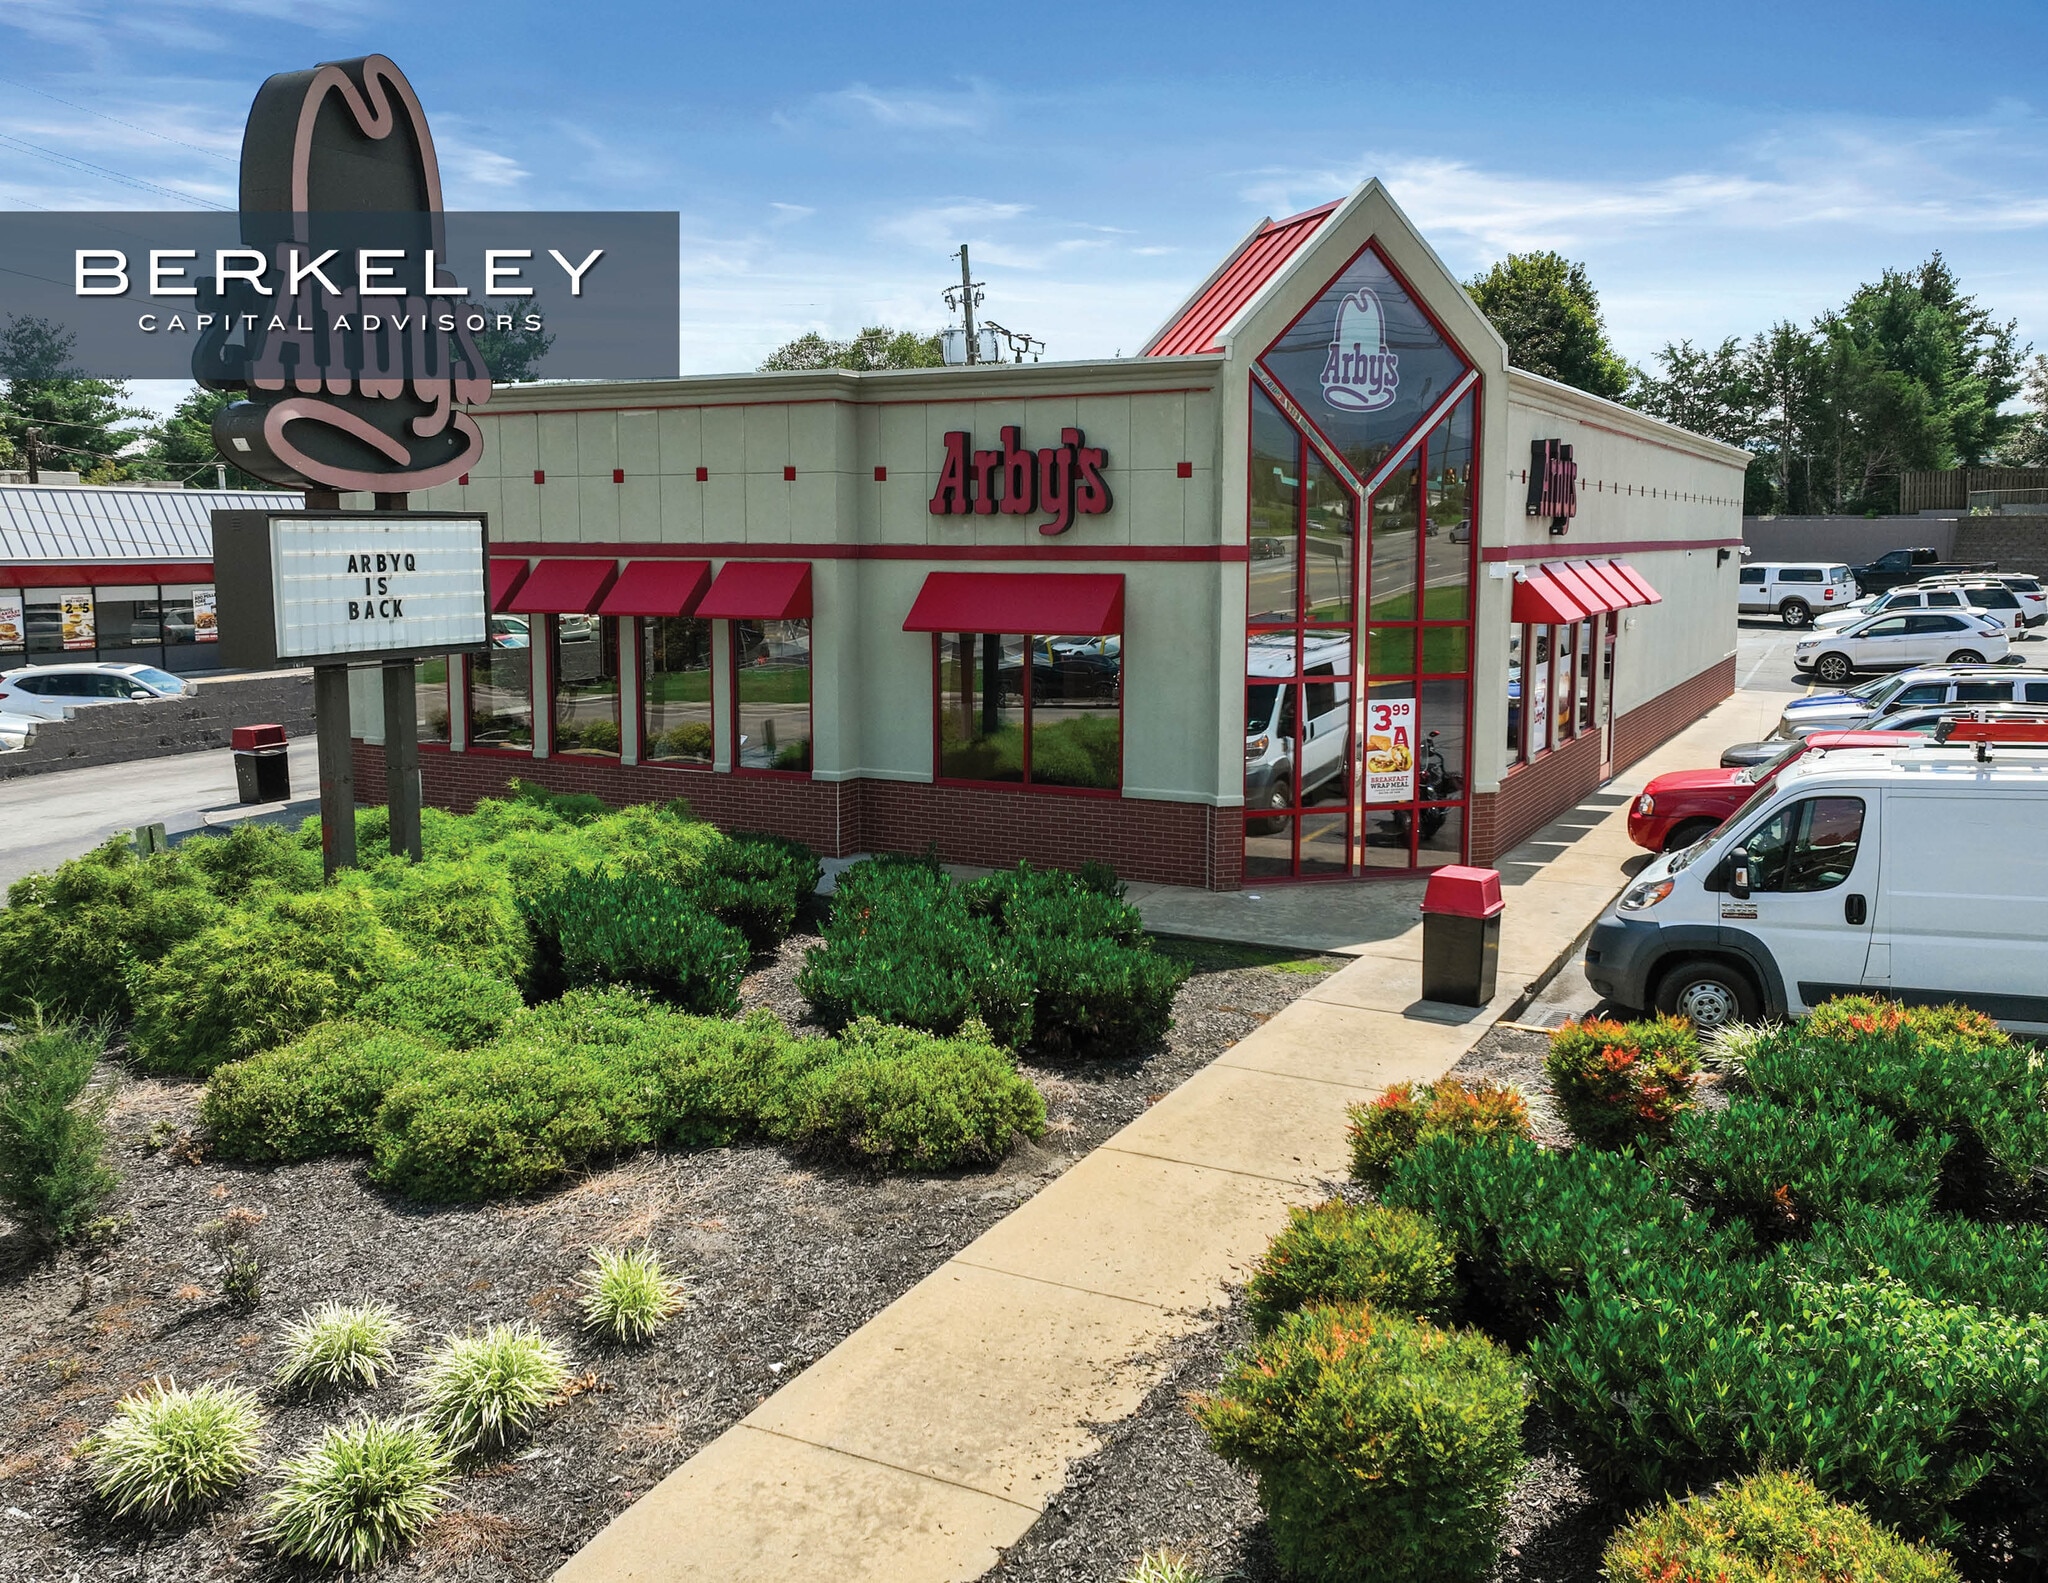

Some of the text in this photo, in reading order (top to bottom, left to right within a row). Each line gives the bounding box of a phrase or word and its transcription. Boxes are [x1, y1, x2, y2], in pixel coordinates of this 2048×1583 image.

[1321, 343, 1398, 395] Arby's
[929, 426, 1113, 535] Arby's
[347, 553, 416, 573] ARBYQ
[365, 577, 387, 595] IS
[348, 599, 403, 620] BACK
